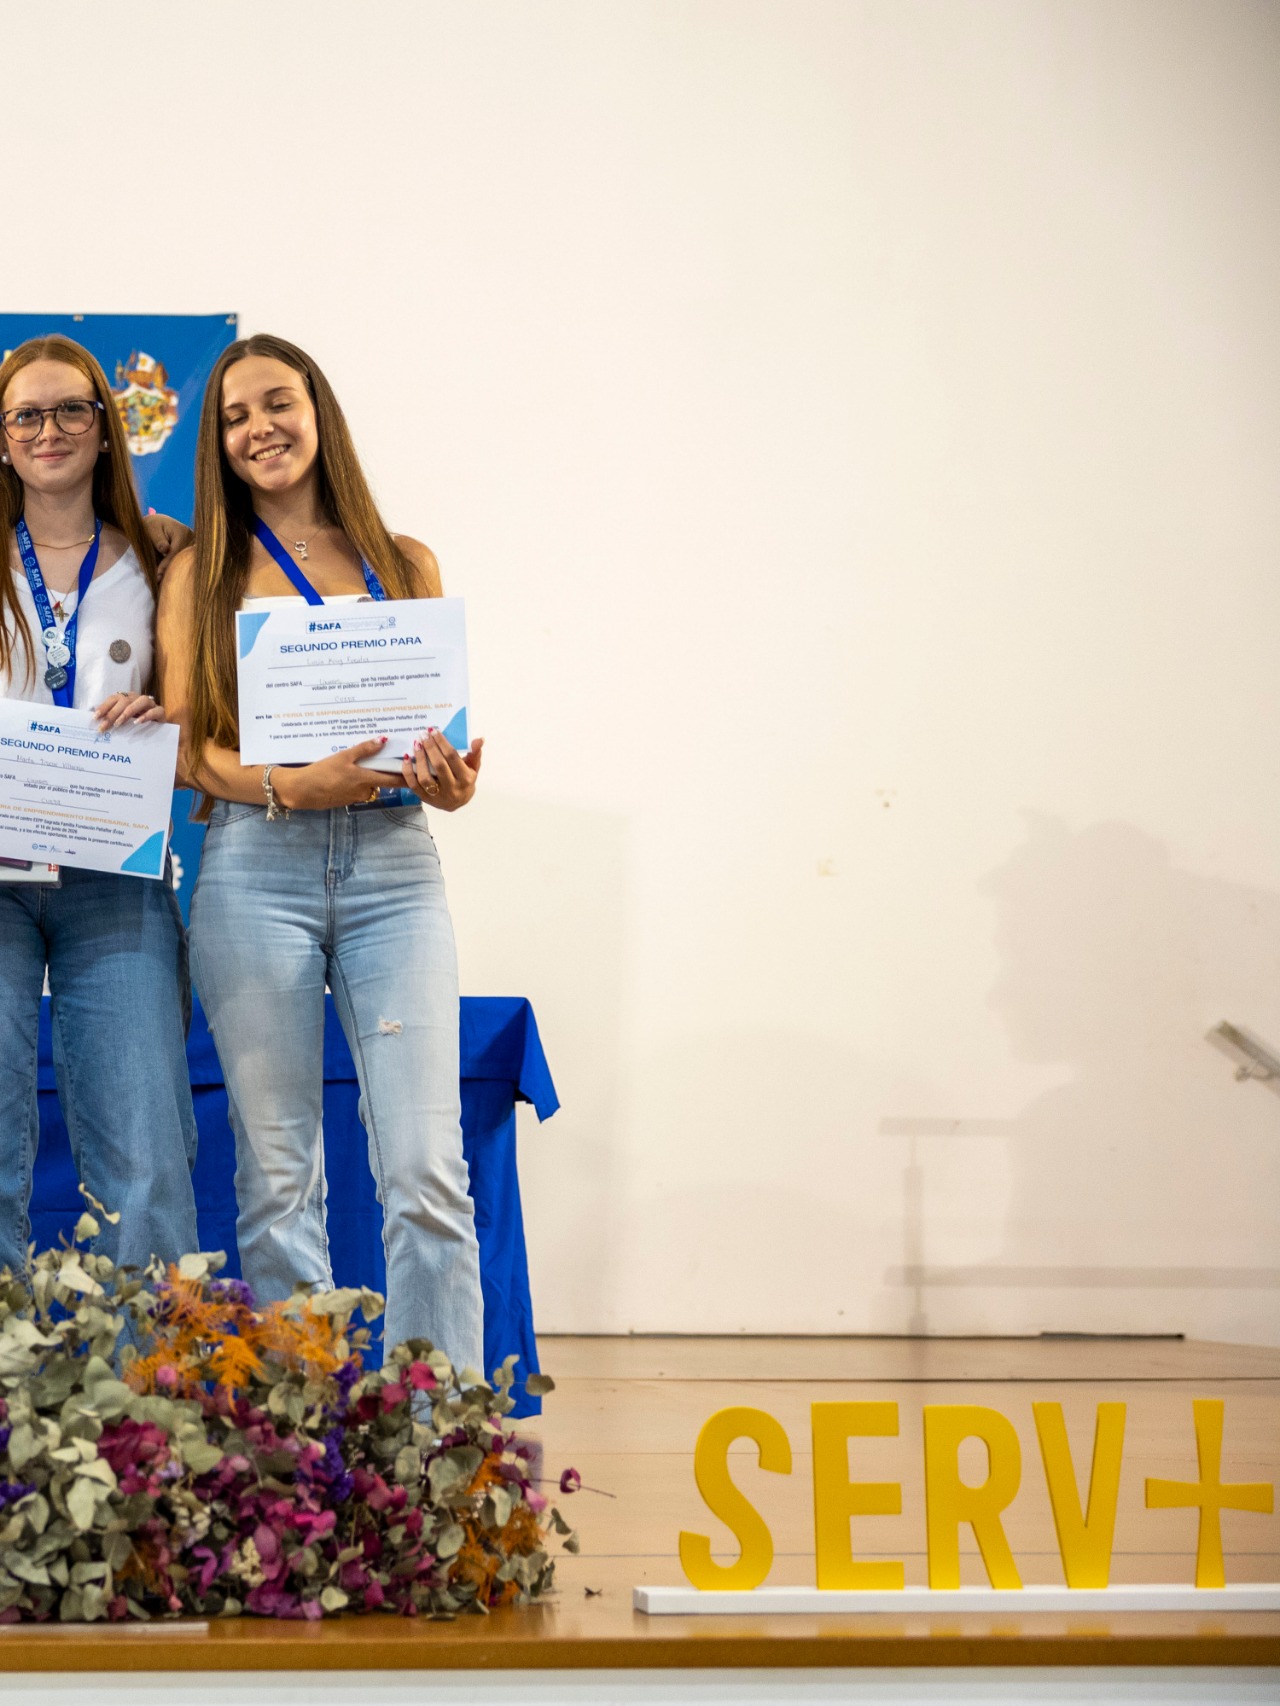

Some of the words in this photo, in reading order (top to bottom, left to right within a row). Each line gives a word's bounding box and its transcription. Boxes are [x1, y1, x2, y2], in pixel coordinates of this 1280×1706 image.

[31, 568, 43, 588] SAFA
[42, 605, 54, 624] SAFA
[309, 621, 341, 632] #SAFA
[280, 642, 338, 653] SEGUNDO
[341, 638, 387, 649] PREMIO
[391, 636, 422, 646] PARA
[30, 722, 61, 734] #SAFA
[0, 737, 54, 753] SEGUNDO
[57, 746, 100, 760] PREMIO
[102, 752, 132, 764] PARA
[85, 786, 105, 794] resultado
[111, 790, 133, 798] ganador/a
[679, 1399, 1274, 1591] SERV+
